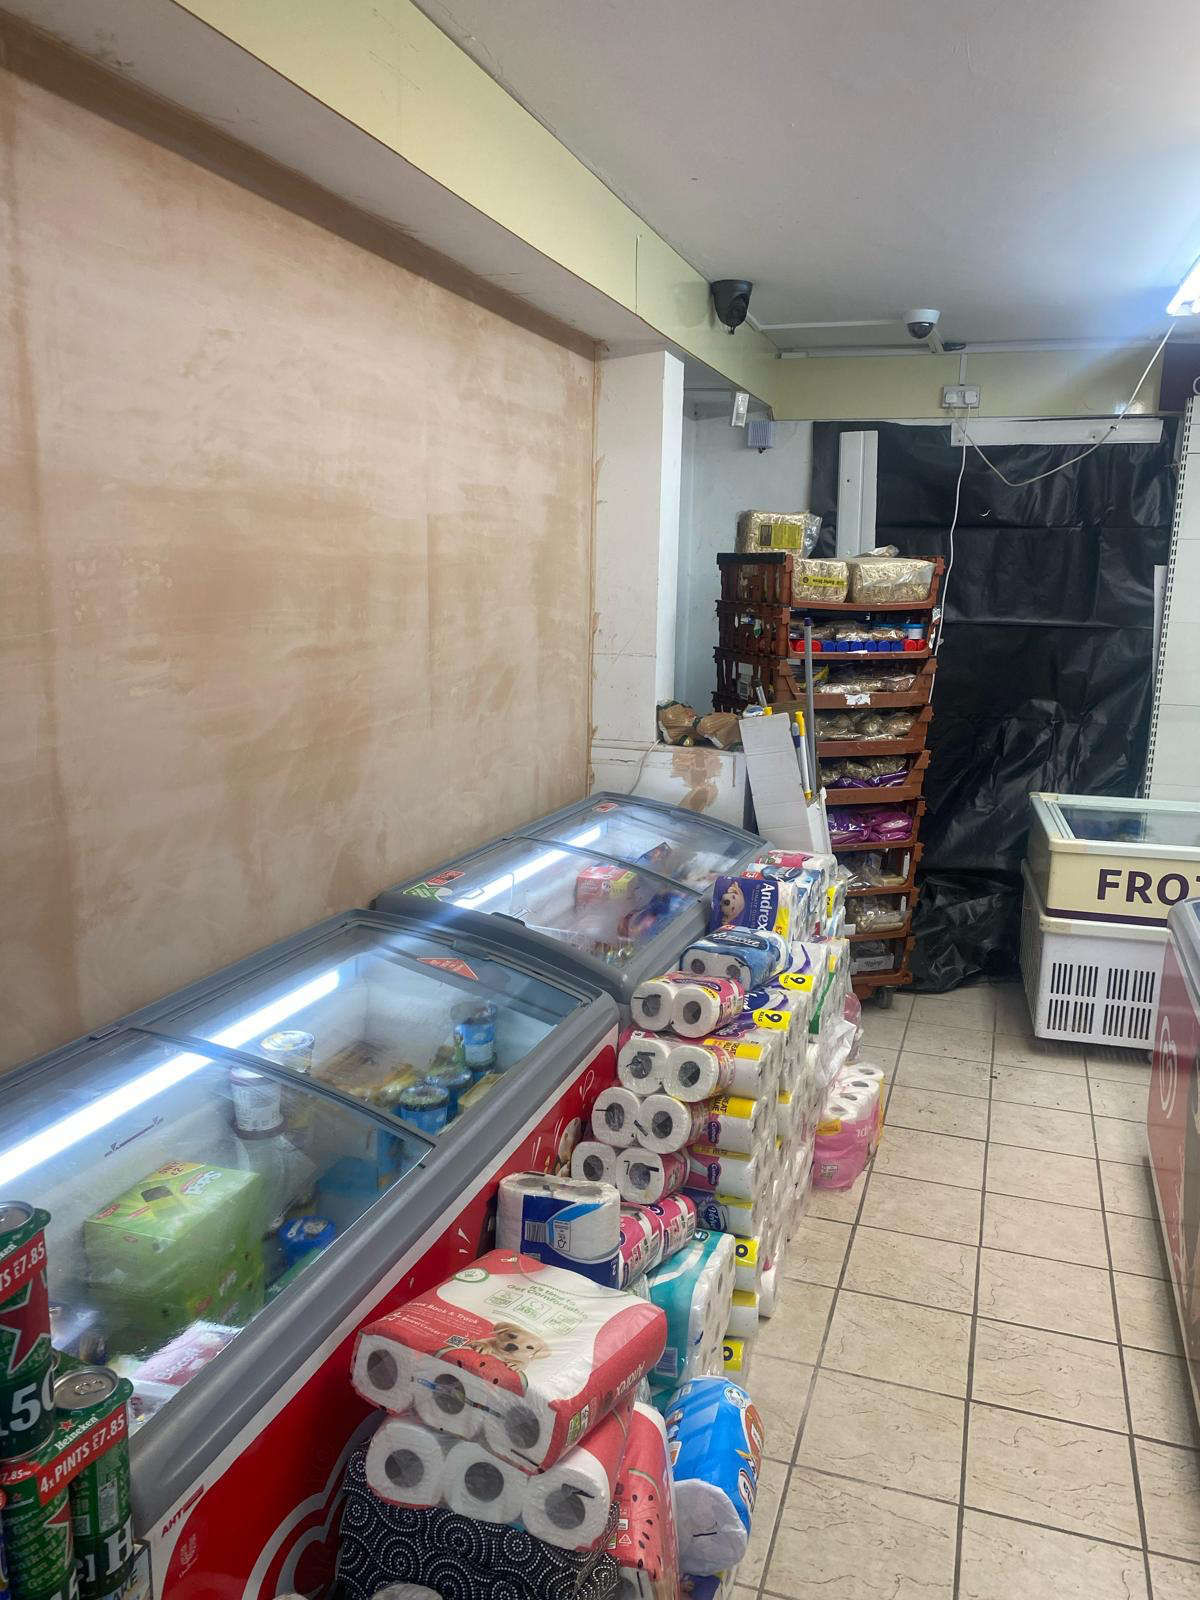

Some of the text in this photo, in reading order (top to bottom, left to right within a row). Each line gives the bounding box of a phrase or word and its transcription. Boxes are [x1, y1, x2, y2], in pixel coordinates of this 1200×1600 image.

[1097, 868, 1200, 906] FRO
[757, 882, 776, 931] Andrex
[764, 1013, 783, 1023] 9
[54, 1415, 98, 1451] Heineken
[54, 1441, 90, 1482] PINTS
[92, 1413, 125, 1451] £7.85
